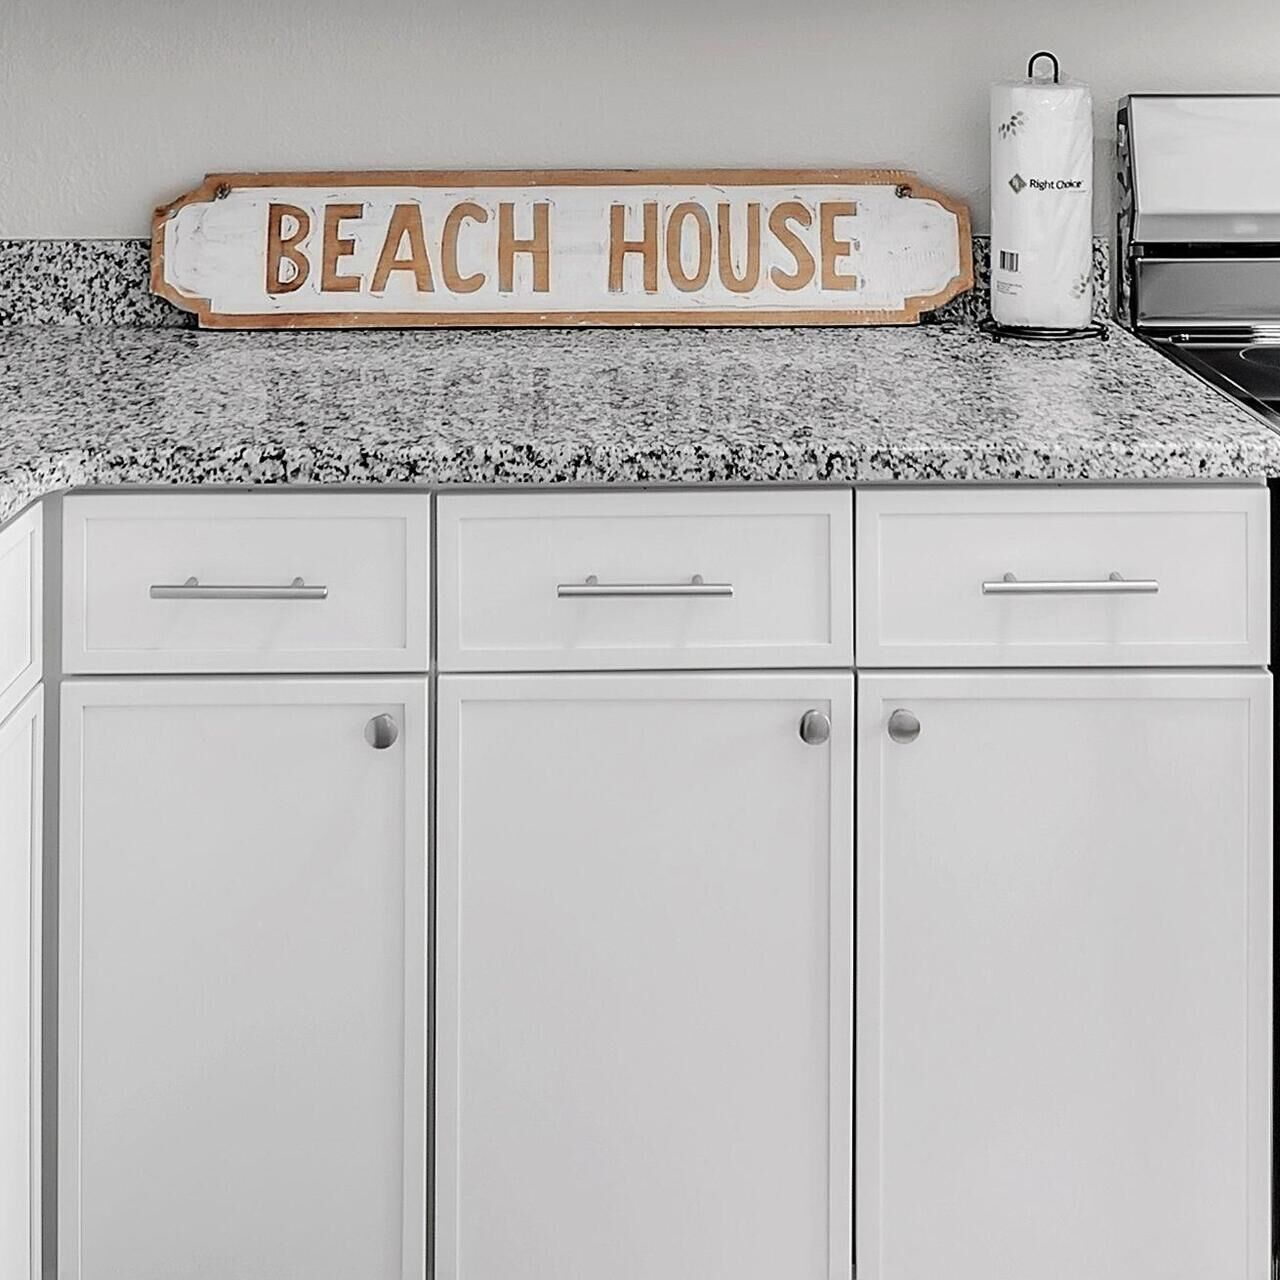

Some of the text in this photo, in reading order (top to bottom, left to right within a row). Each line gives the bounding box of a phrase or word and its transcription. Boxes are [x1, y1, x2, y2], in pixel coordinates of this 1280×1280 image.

[1029, 179, 1055, 191] Right
[266, 202, 858, 293] BEACH HOUSE
